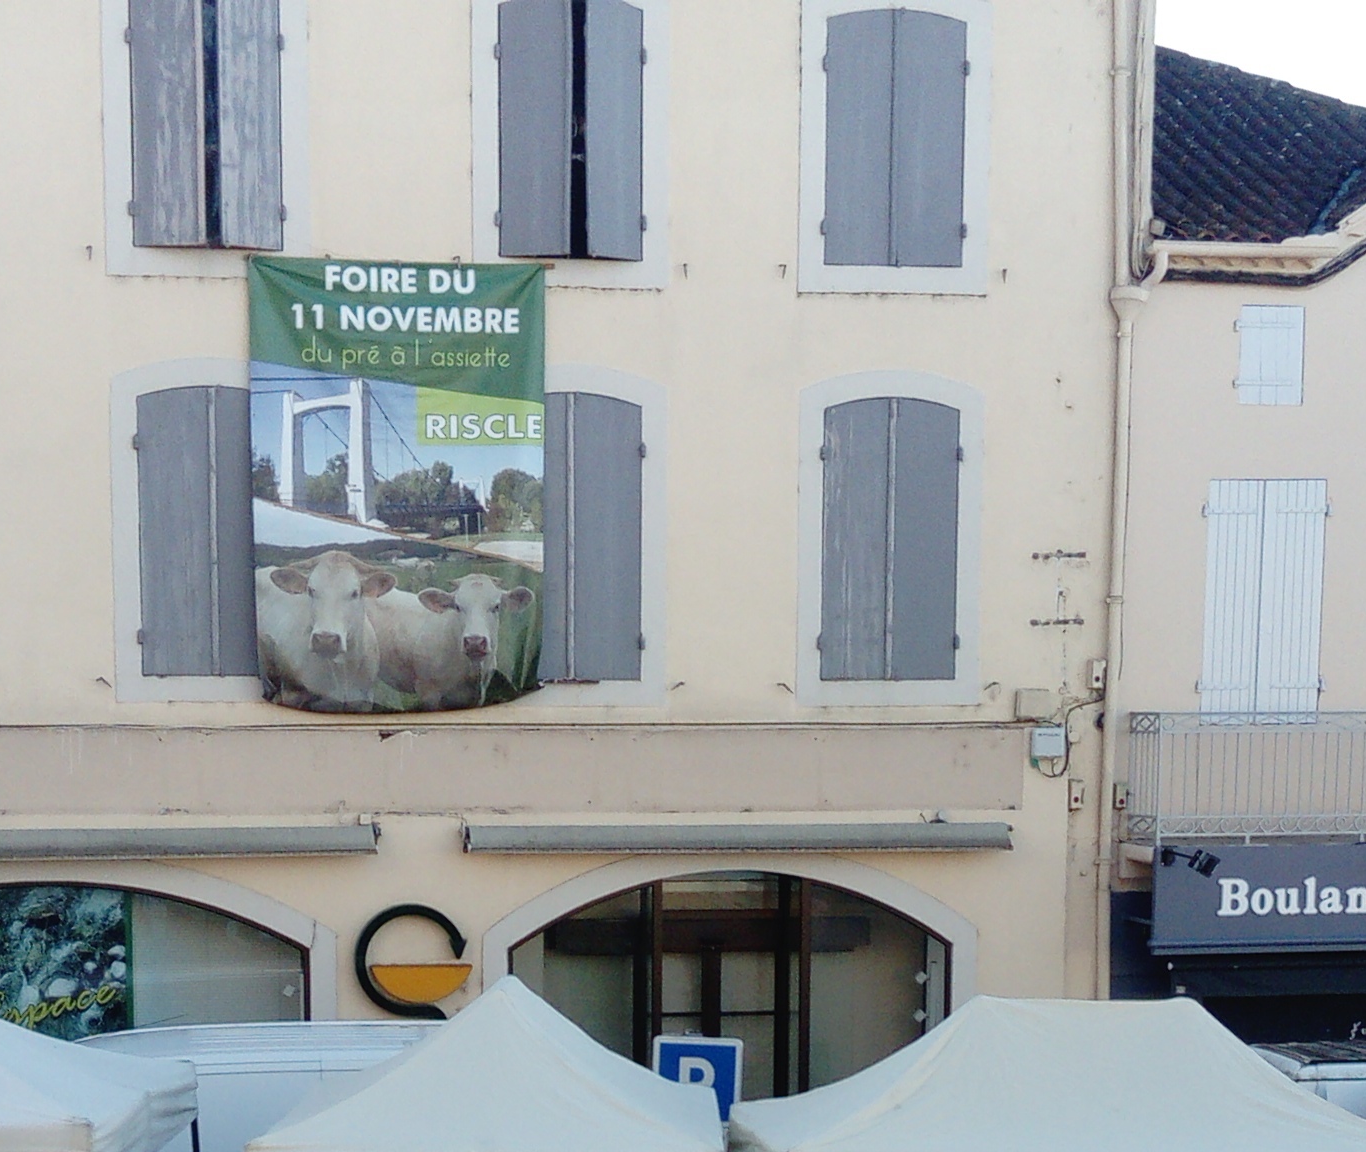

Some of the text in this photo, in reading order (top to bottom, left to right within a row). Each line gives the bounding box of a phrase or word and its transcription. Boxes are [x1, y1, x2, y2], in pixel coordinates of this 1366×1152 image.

[325, 265, 476, 295] FOIRE DU
[291, 303, 520, 334] 11 NOVEMBRE
[301, 335, 332, 363] du
[342, 345, 379, 369] pré
[391, 347, 406, 366] à
[426, 413, 542, 440] RISCLE
[679, 1056, 715, 1087] P
